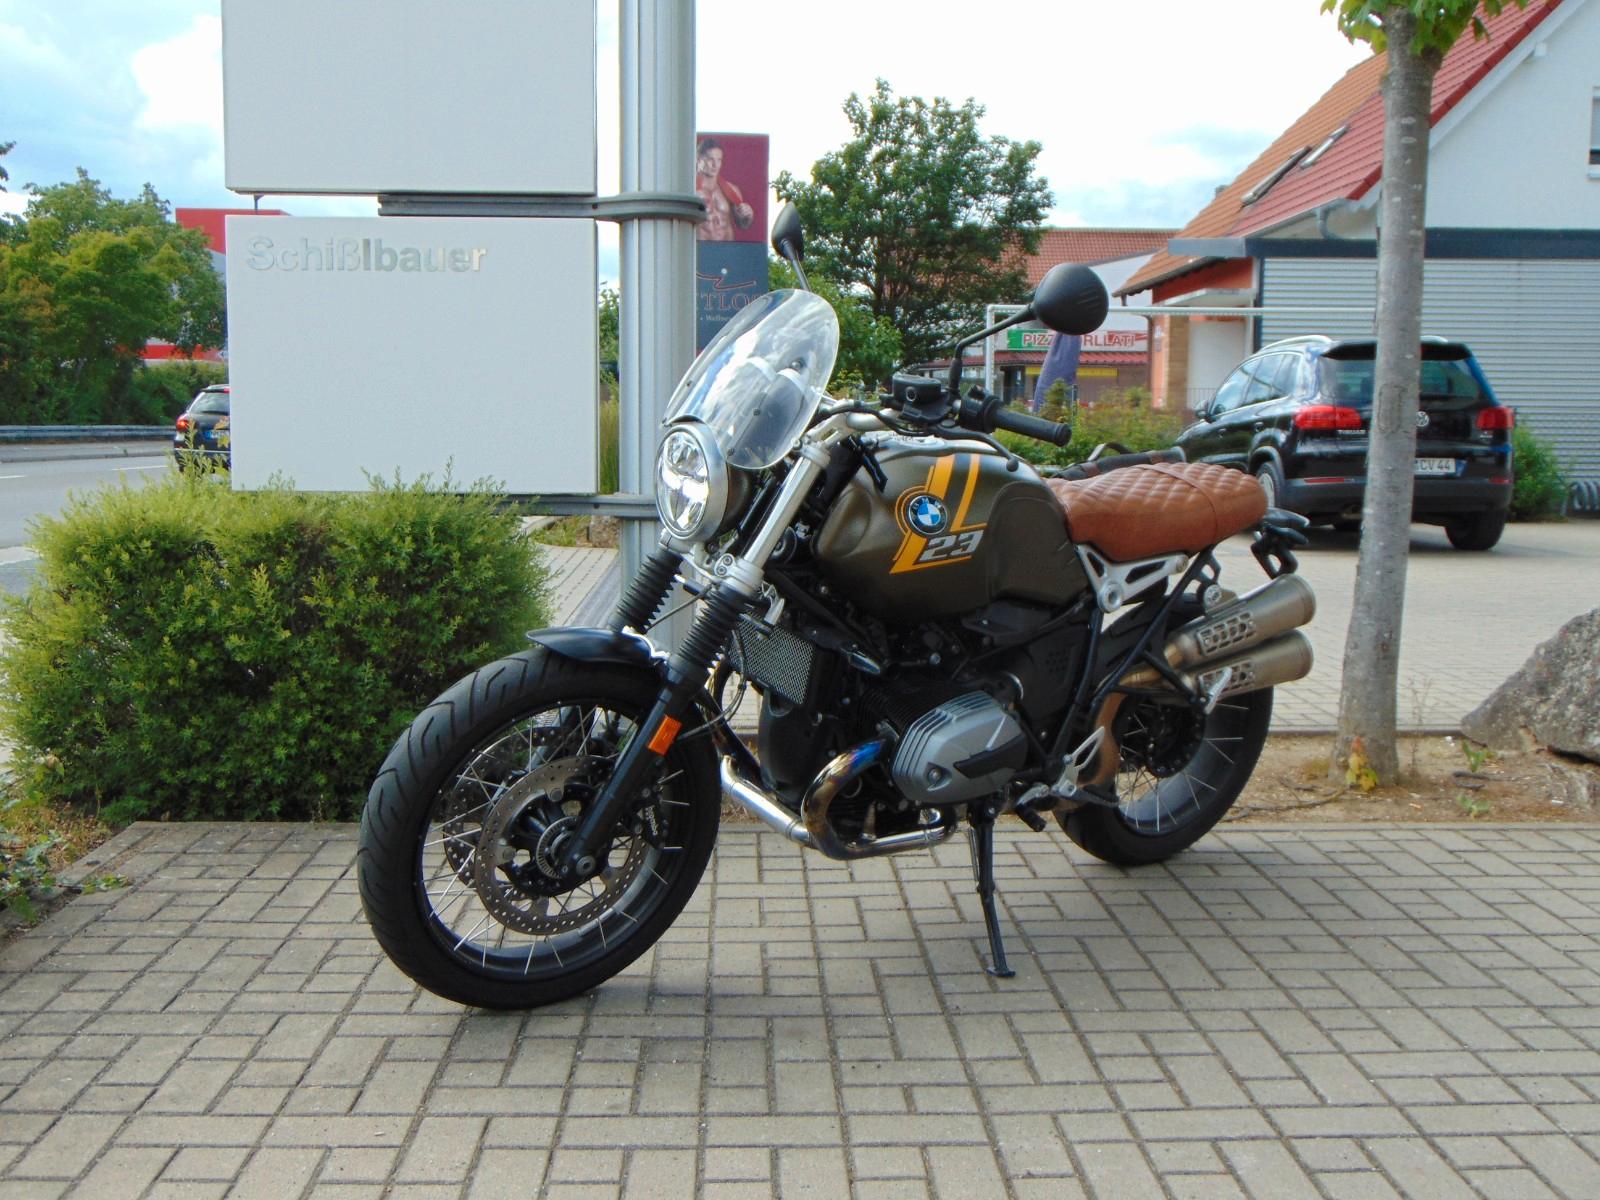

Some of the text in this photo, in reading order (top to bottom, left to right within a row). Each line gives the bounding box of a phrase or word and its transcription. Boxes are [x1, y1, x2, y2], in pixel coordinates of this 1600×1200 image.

[248, 236, 486, 272] Schißlbauer
[1023, 333, 1135, 347] PIZZ RLLATI
